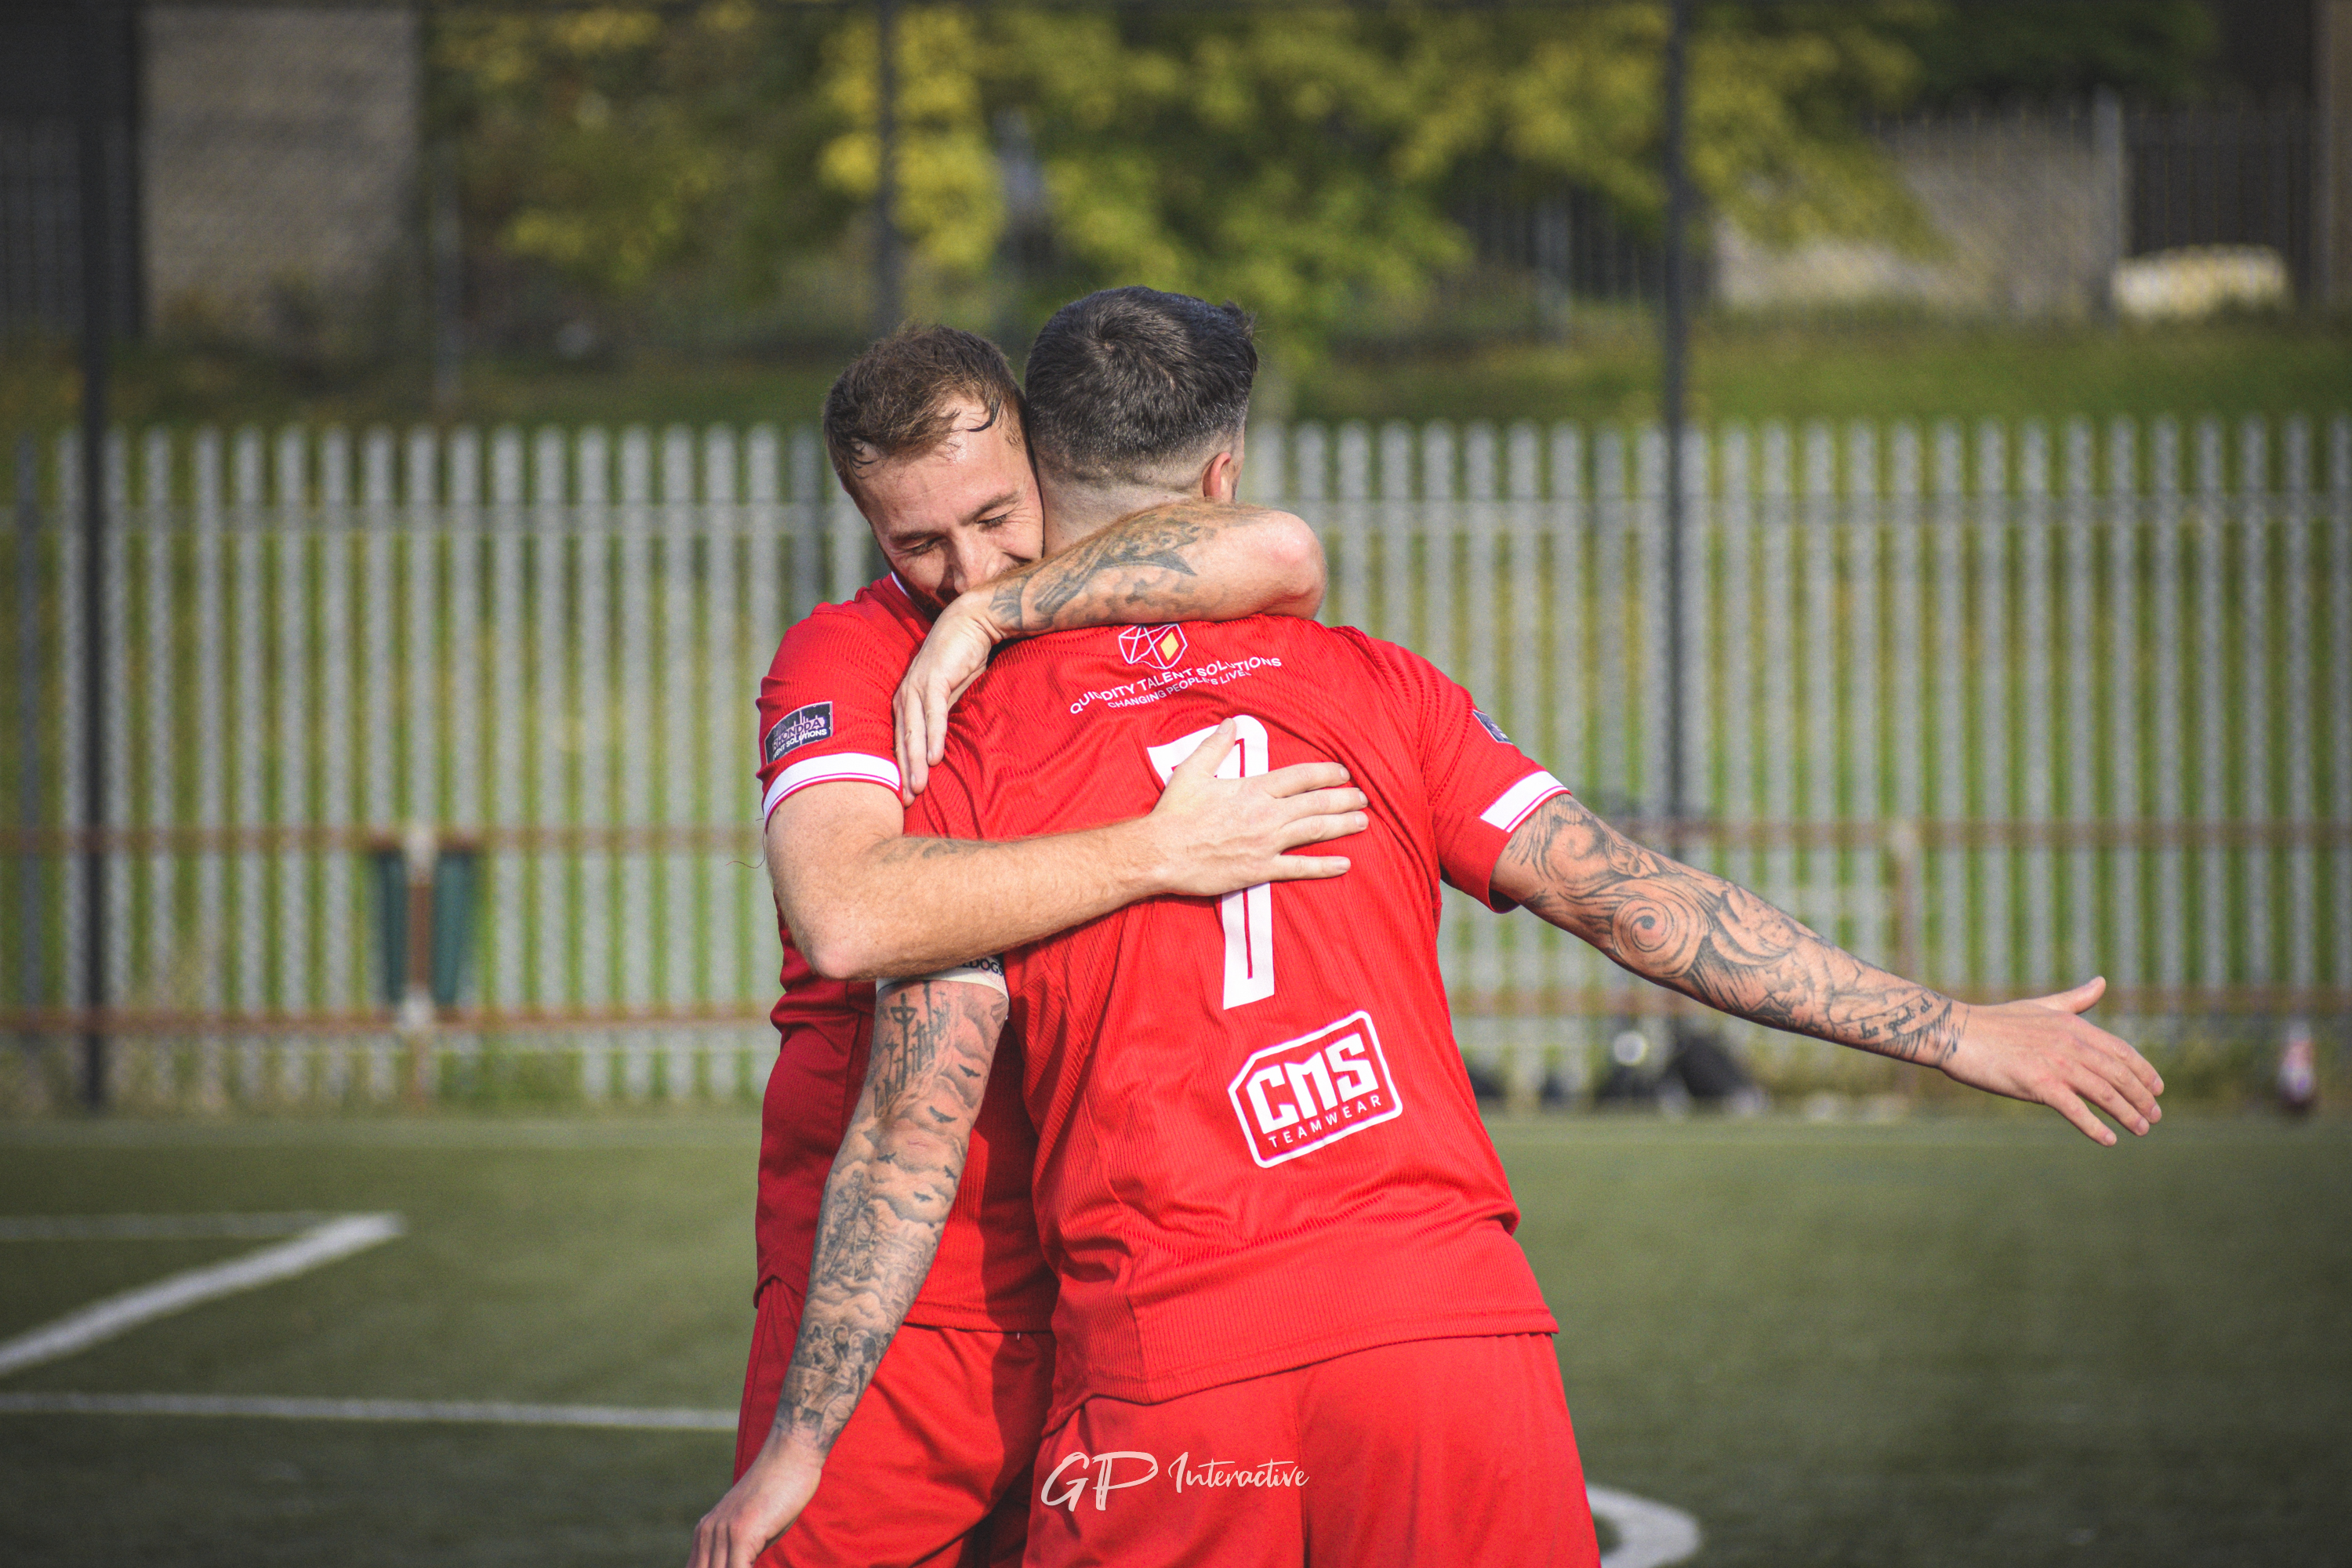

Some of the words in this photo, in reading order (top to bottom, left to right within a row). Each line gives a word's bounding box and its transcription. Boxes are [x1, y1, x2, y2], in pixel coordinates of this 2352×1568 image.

[1107, 690, 1167, 708] CHANGING
[1165, 677, 1219, 695] PEOPLE'S
[1137, 668, 1192, 691] TALENT
[1196, 656, 1283, 677] SOLUTIONS
[786, 728, 827, 748] SOLUTIONS
[1146, 714, 1275, 1011] 7
[1246, 1033, 1379, 1134] CMS
[1269, 1094, 1381, 1149] TEAMWEAR
